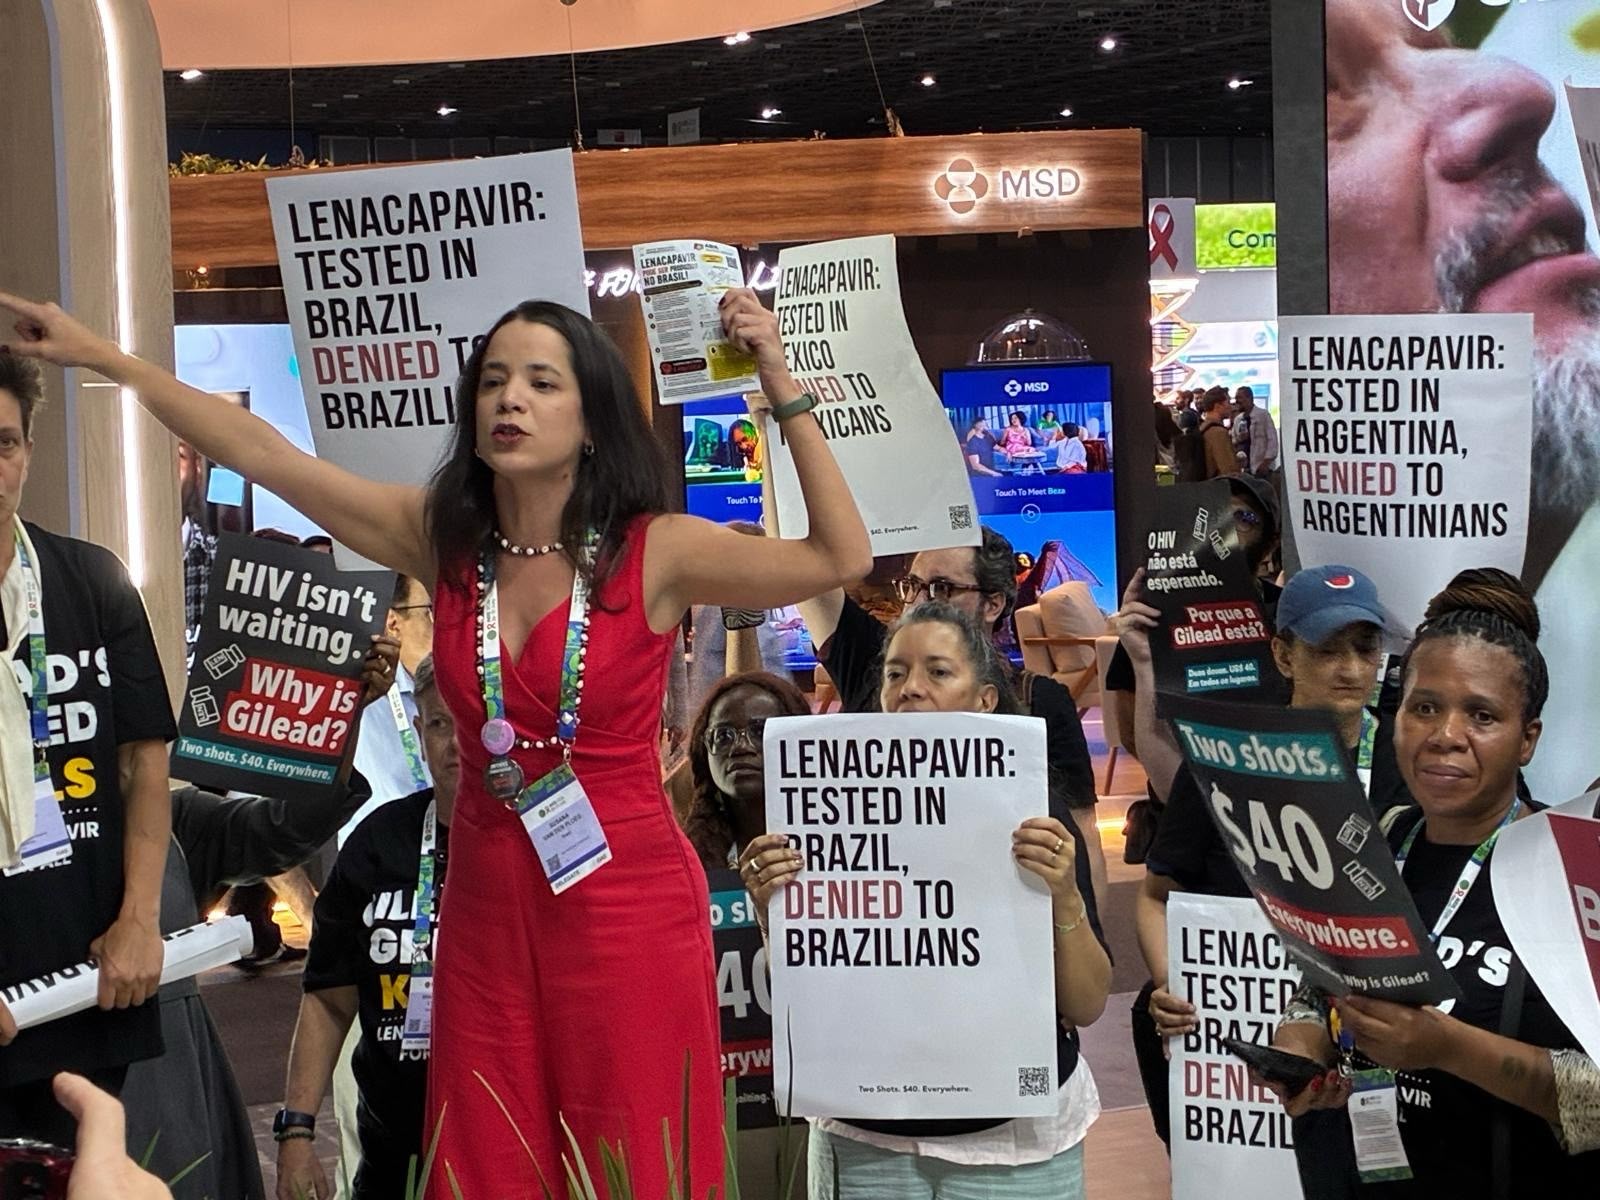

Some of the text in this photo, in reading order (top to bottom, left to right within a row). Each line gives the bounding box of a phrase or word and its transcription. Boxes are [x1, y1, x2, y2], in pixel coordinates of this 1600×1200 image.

[1001, 168, 1081, 198] MSD
[288, 181, 546, 243] LENACAPAVIR:
[295, 237, 478, 291] TESTED IN
[641, 253, 696, 269] LENACAPAVIR
[644, 271, 688, 286] NO BRASIL!
[779, 258, 880, 299] LENACAPAVIR:
[304, 292, 443, 339] BRAZIL,
[778, 299, 848, 336] TESTED IN
[312, 340, 440, 385] DENIED
[783, 340, 835, 372] EXICO
[1292, 335, 1505, 371] LENACAPAVIR:
[795, 372, 876, 404] NIED TO
[1024, 382, 1049, 392] MSD
[1292, 378, 1440, 413] TESTED IN
[780, 404, 892, 446] XICANS
[1295, 419, 1468, 459] ARGENTINA,
[995, 488, 1017, 497] Touch
[1017, 488, 1027, 496] To
[1297, 459, 1444, 497] DENIED TO
[726, 496, 748, 504] Touch
[748, 496, 758, 504] To
[1303, 499, 1508, 538] ARGENTINIANS
[1148, 530, 1176, 550] O HIV
[1147, 551, 1198, 571] não está
[226, 558, 377, 623] HIV isn't
[1147, 570, 1224, 593] esperando.
[1174, 622, 1266, 646] Gilead está?
[1187, 607, 1256, 623] Por que a
[219, 605, 362, 665] waiting.
[251, 663, 358, 716] Why is
[227, 699, 348, 750] Gilead?
[180, 739, 331, 781] Two shots. $40. Everywhere.
[780, 738, 1016, 778] LENACAPAVIR:
[1179, 724, 1340, 776] Two shots.
[780, 786, 946, 825] TESTED IN
[1211, 782, 1334, 889] $40
[784, 880, 954, 920] DENIED TO
[1260, 892, 1409, 949] Everywhere.
[786, 927, 980, 967] BRAZILIANS
[1343, 971, 1430, 991] Why is Gilead?
[859, 1084, 973, 1095] Two Shots. $40. Everywhere.
[1185, 1105, 1296, 1149] BRAZIL
